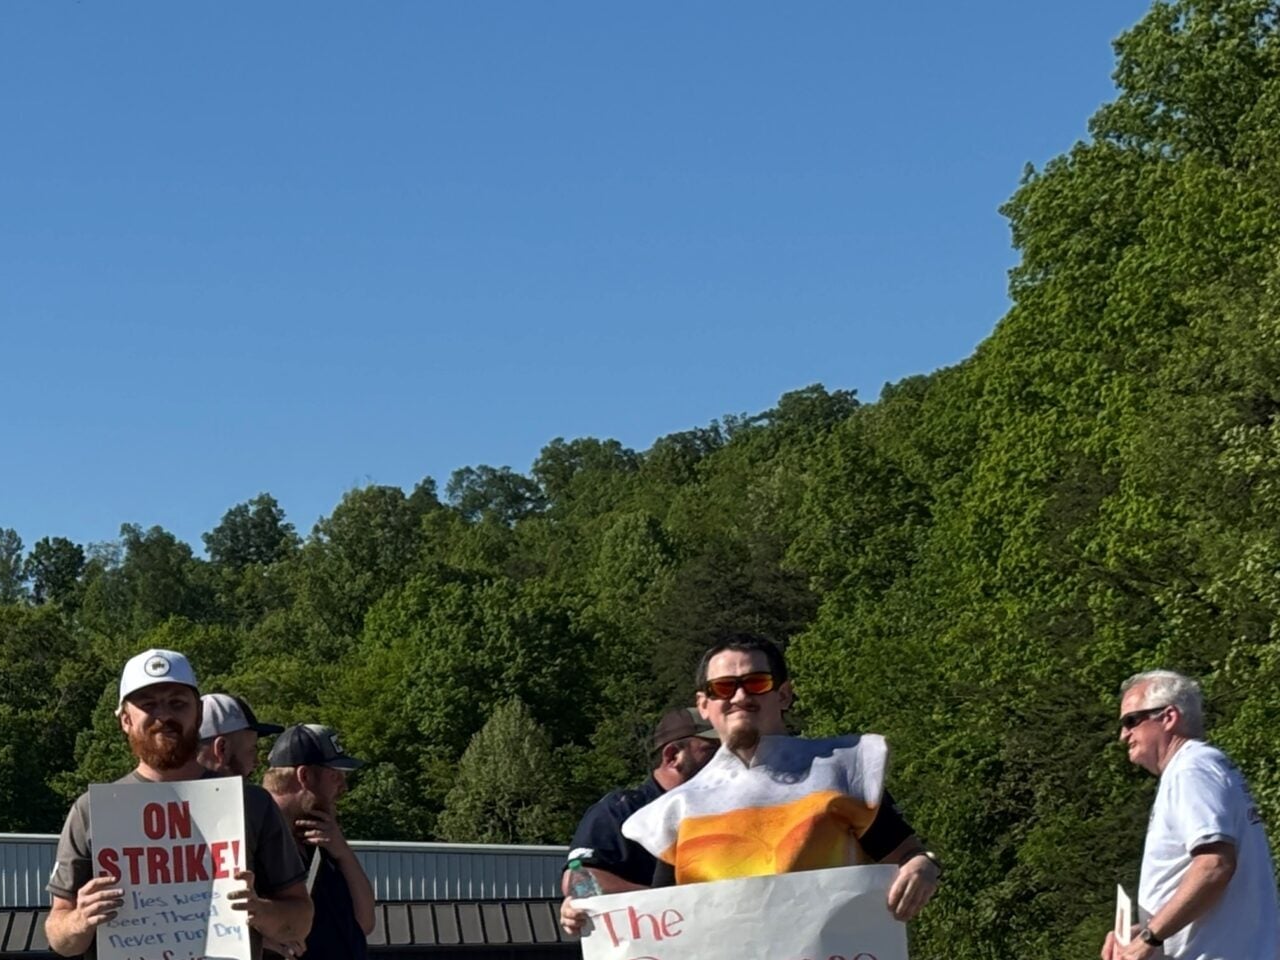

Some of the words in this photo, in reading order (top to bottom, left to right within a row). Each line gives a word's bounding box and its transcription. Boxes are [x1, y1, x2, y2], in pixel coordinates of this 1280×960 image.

[143, 800, 192, 840] ON
[97, 840, 241, 885] STRIKE!
[591, 906, 684, 948] The
